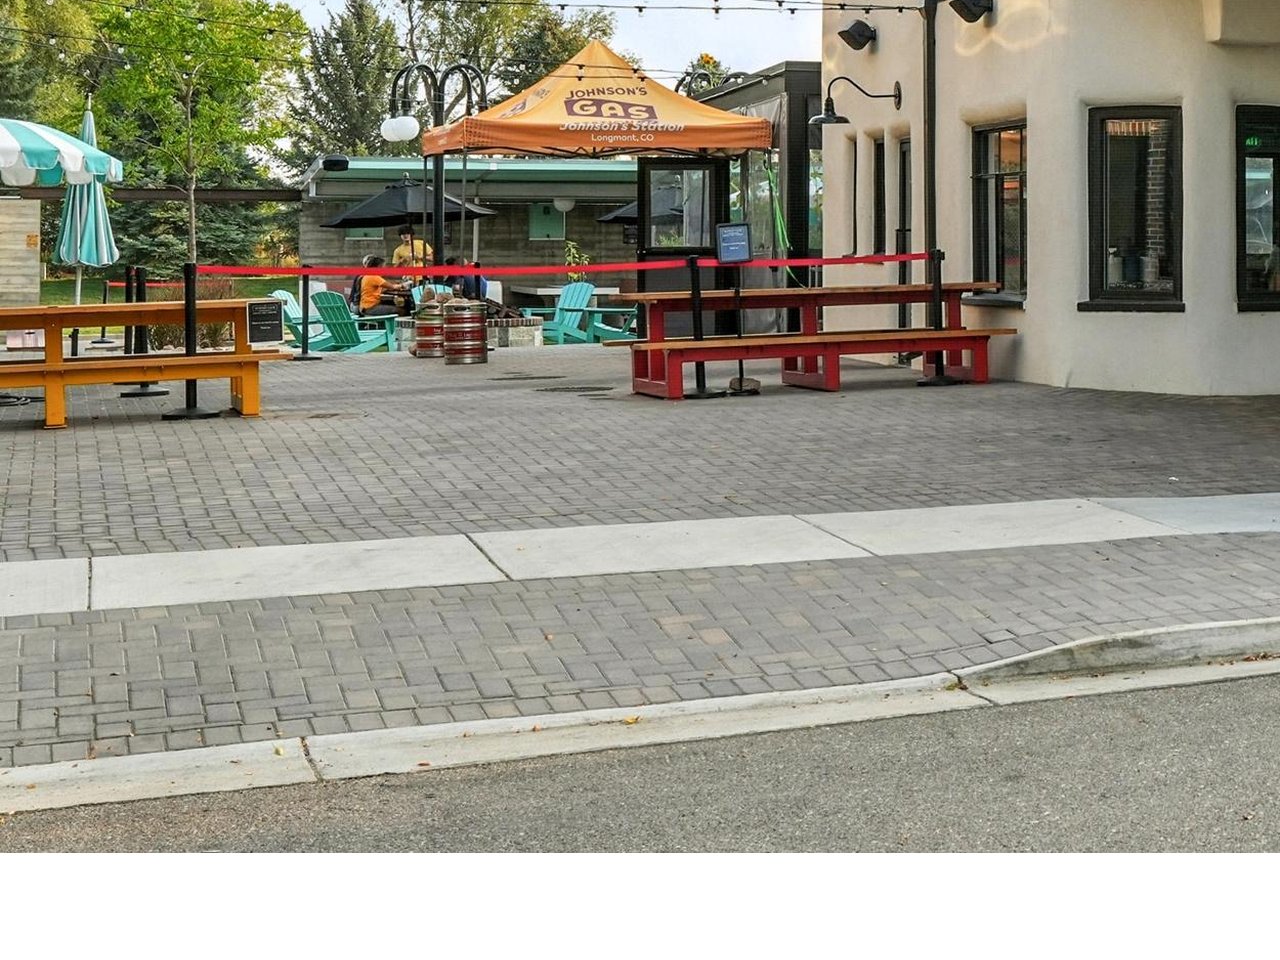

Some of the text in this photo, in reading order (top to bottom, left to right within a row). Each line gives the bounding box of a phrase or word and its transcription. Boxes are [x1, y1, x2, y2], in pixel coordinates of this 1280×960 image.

[565, 86, 648, 99] JOHNSON'S
[572, 100, 650, 119] GAS
[560, 120, 684, 131] Johnson's Station
[591, 133, 654, 142] Longmont, CO
